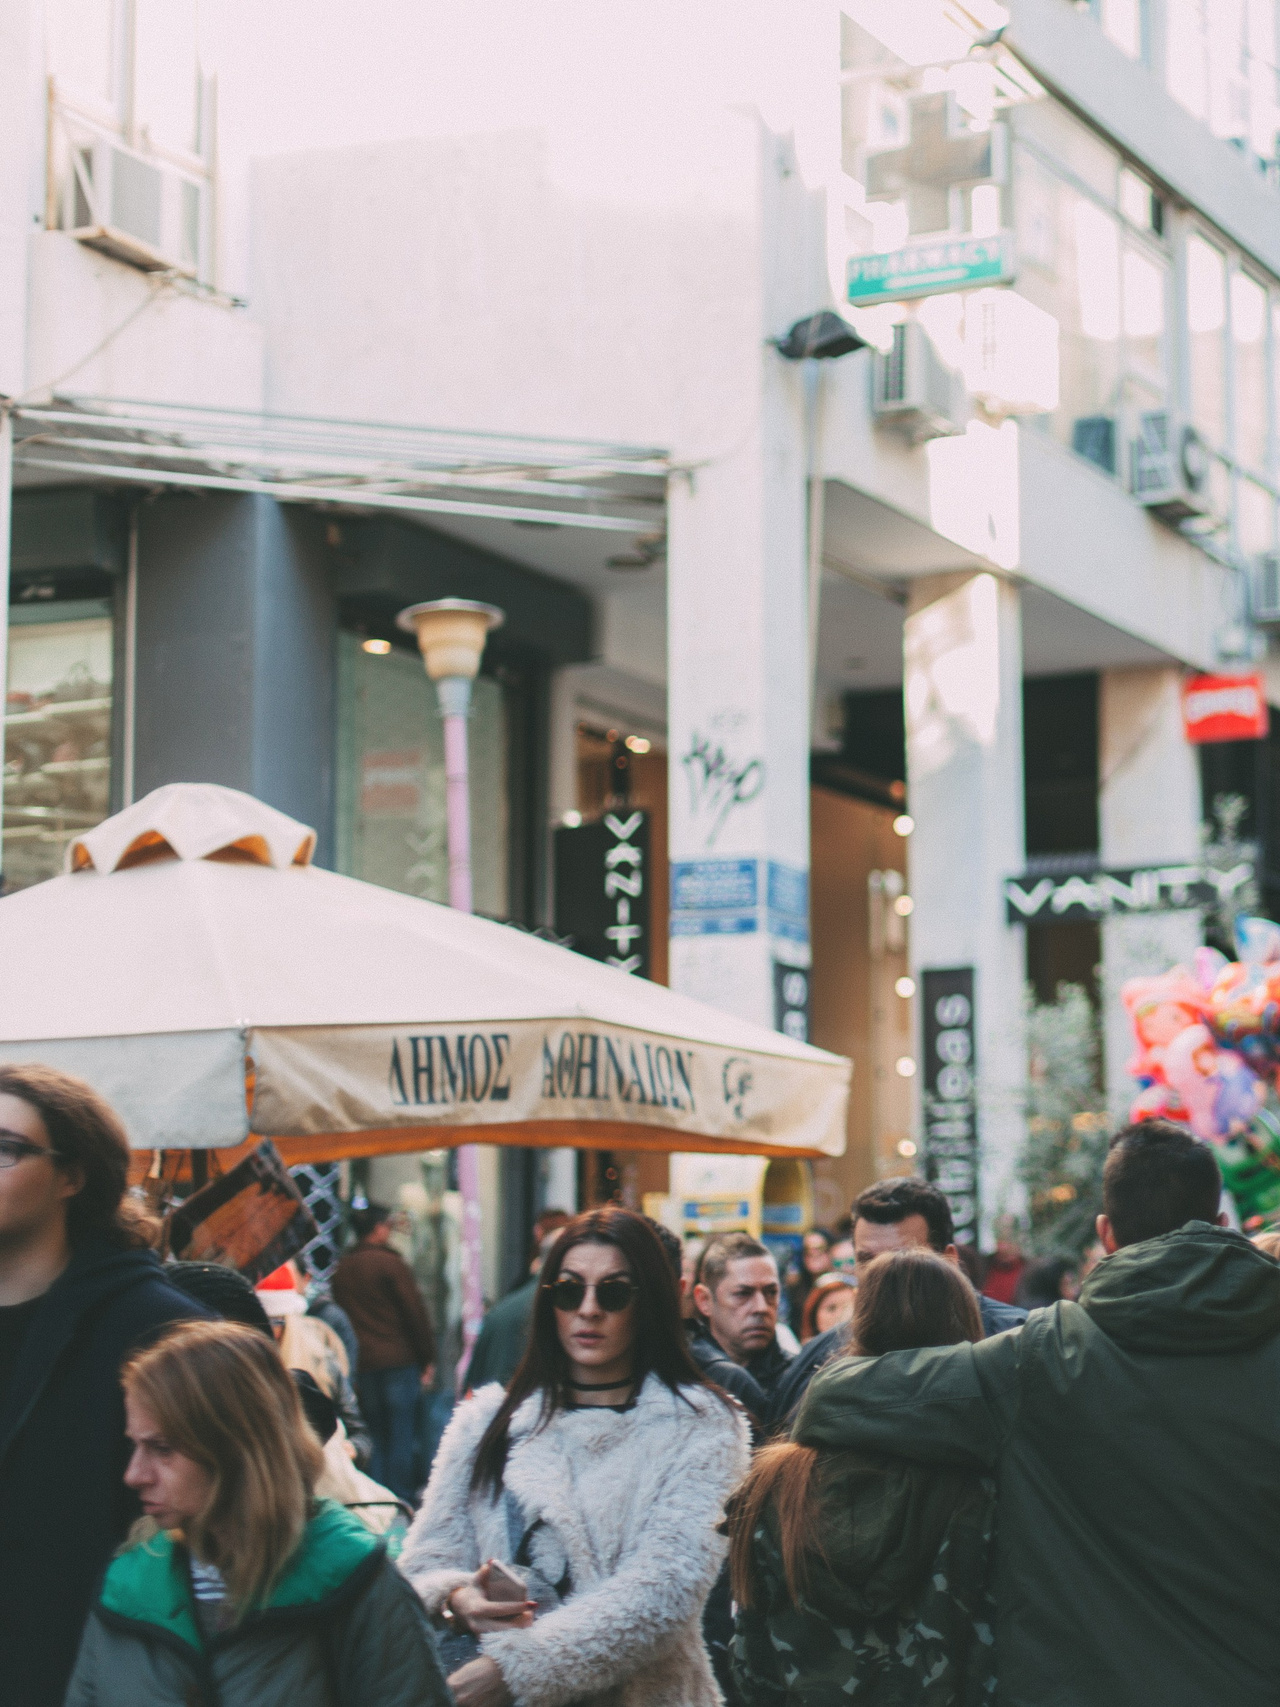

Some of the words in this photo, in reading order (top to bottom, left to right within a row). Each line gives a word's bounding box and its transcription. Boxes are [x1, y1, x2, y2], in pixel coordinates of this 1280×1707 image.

[1004, 863, 1252, 916] VANITY
[388, 1033, 511, 1106] ΔΗΜΟΣ
[541, 1031, 697, 1113] ΑΘΗΝΑΙΩΝ
